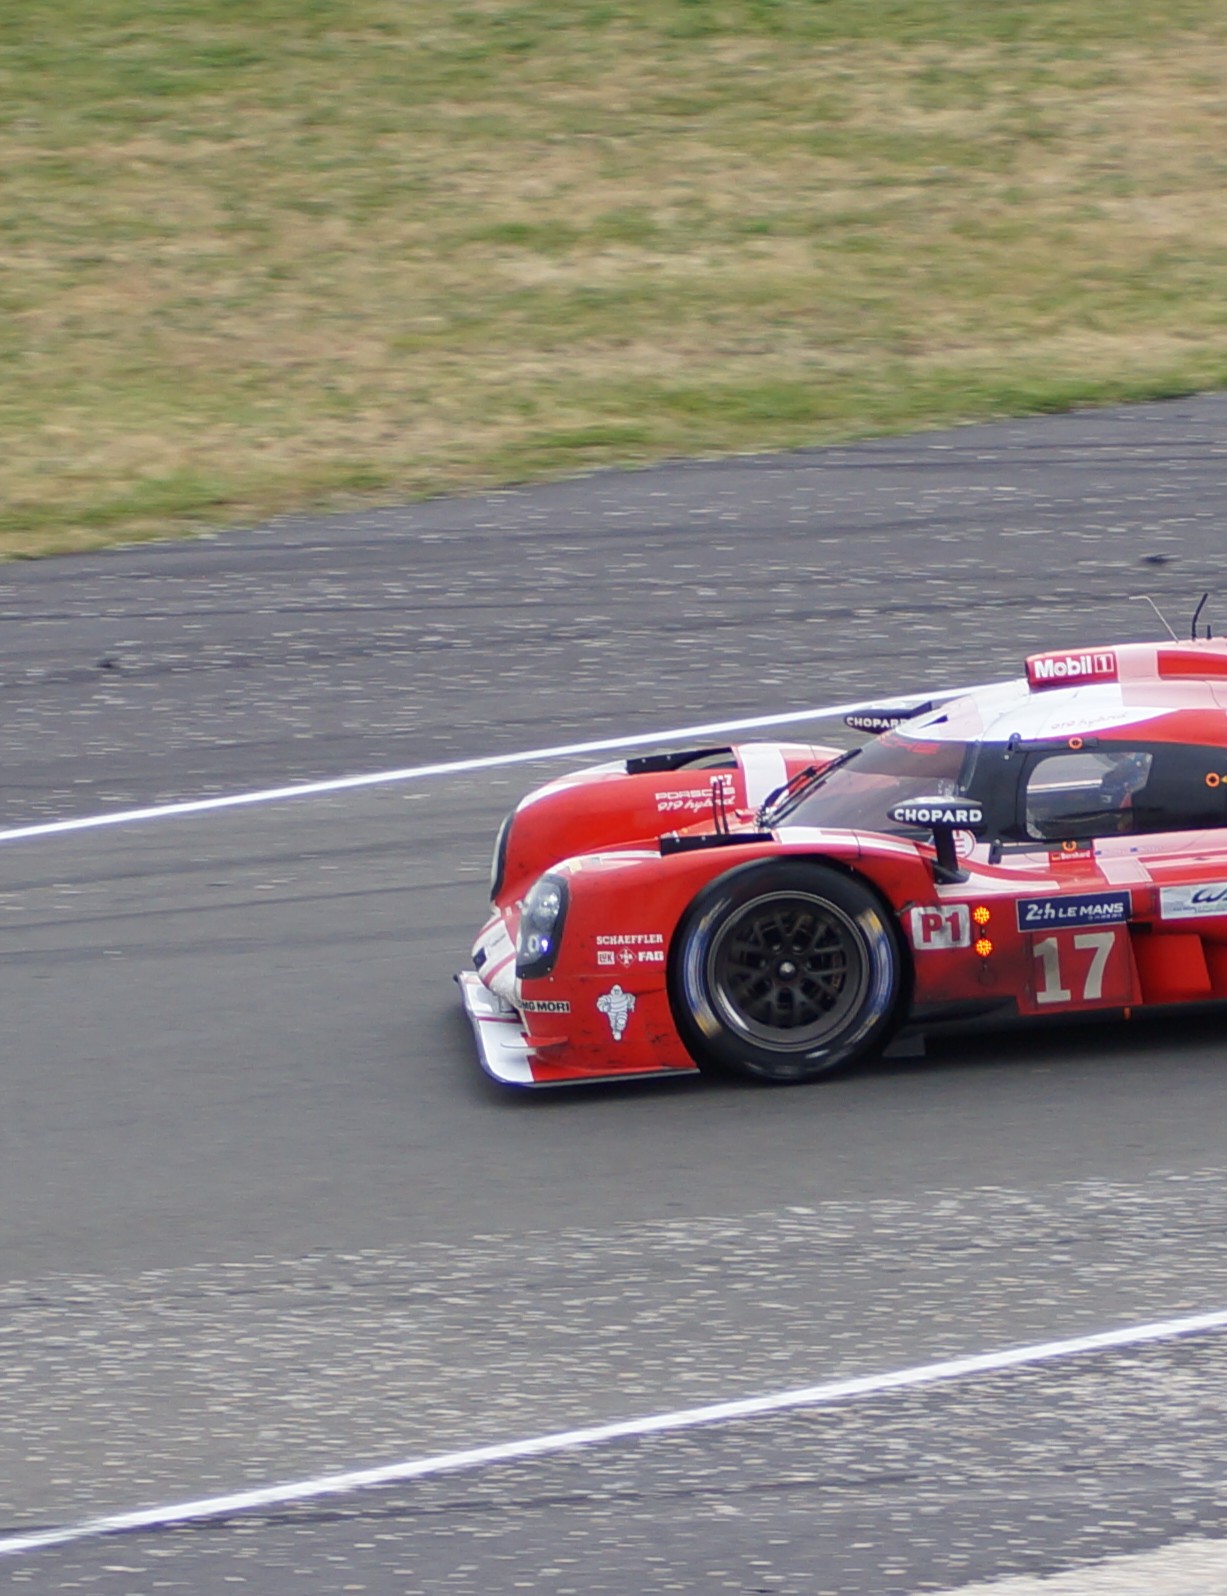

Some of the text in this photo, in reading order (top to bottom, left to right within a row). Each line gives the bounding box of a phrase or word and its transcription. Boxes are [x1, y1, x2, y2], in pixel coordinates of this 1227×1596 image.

[1034, 656, 1093, 678] Mobil
[894, 808, 982, 823] CHOPARD
[1058, 906, 1079, 918] LE
[1080, 902, 1124, 916] MANS
[920, 911, 961, 943] P1
[596, 934, 663, 945] SCHAEFFLER
[638, 950, 664, 962] FAG
[1033, 931, 1115, 1004] 17
[537, 1002, 570, 1012] MORI
